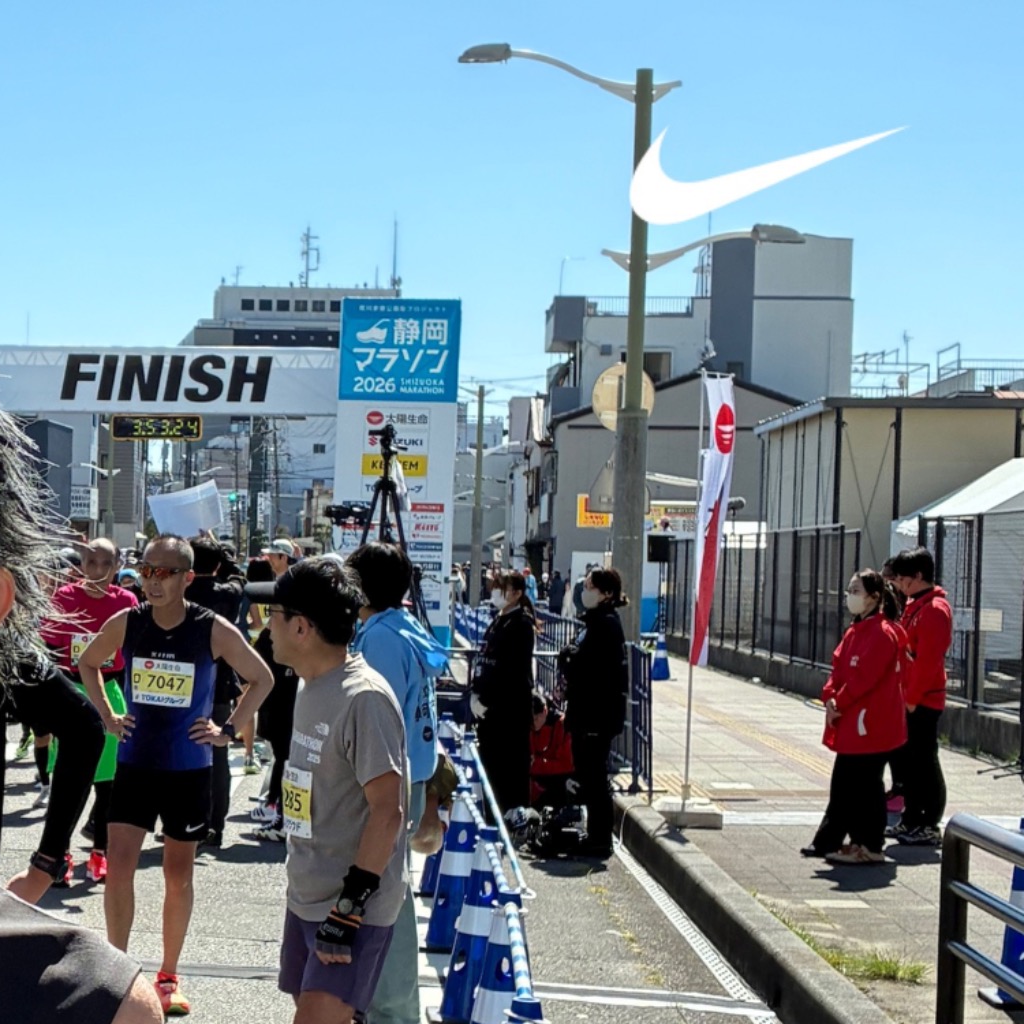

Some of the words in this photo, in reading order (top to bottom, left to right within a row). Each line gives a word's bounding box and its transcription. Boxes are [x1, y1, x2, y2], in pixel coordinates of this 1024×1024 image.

[394, 318, 449, 345] 静岡
[352, 347, 449, 373] マラソン
[60, 353, 273, 402] FINISH
[353, 377, 396, 393] 2026
[400, 378, 444, 386] SHIZUOKA
[384, 438, 423, 446] ZUKI
[146, 674, 185, 691] 7047
